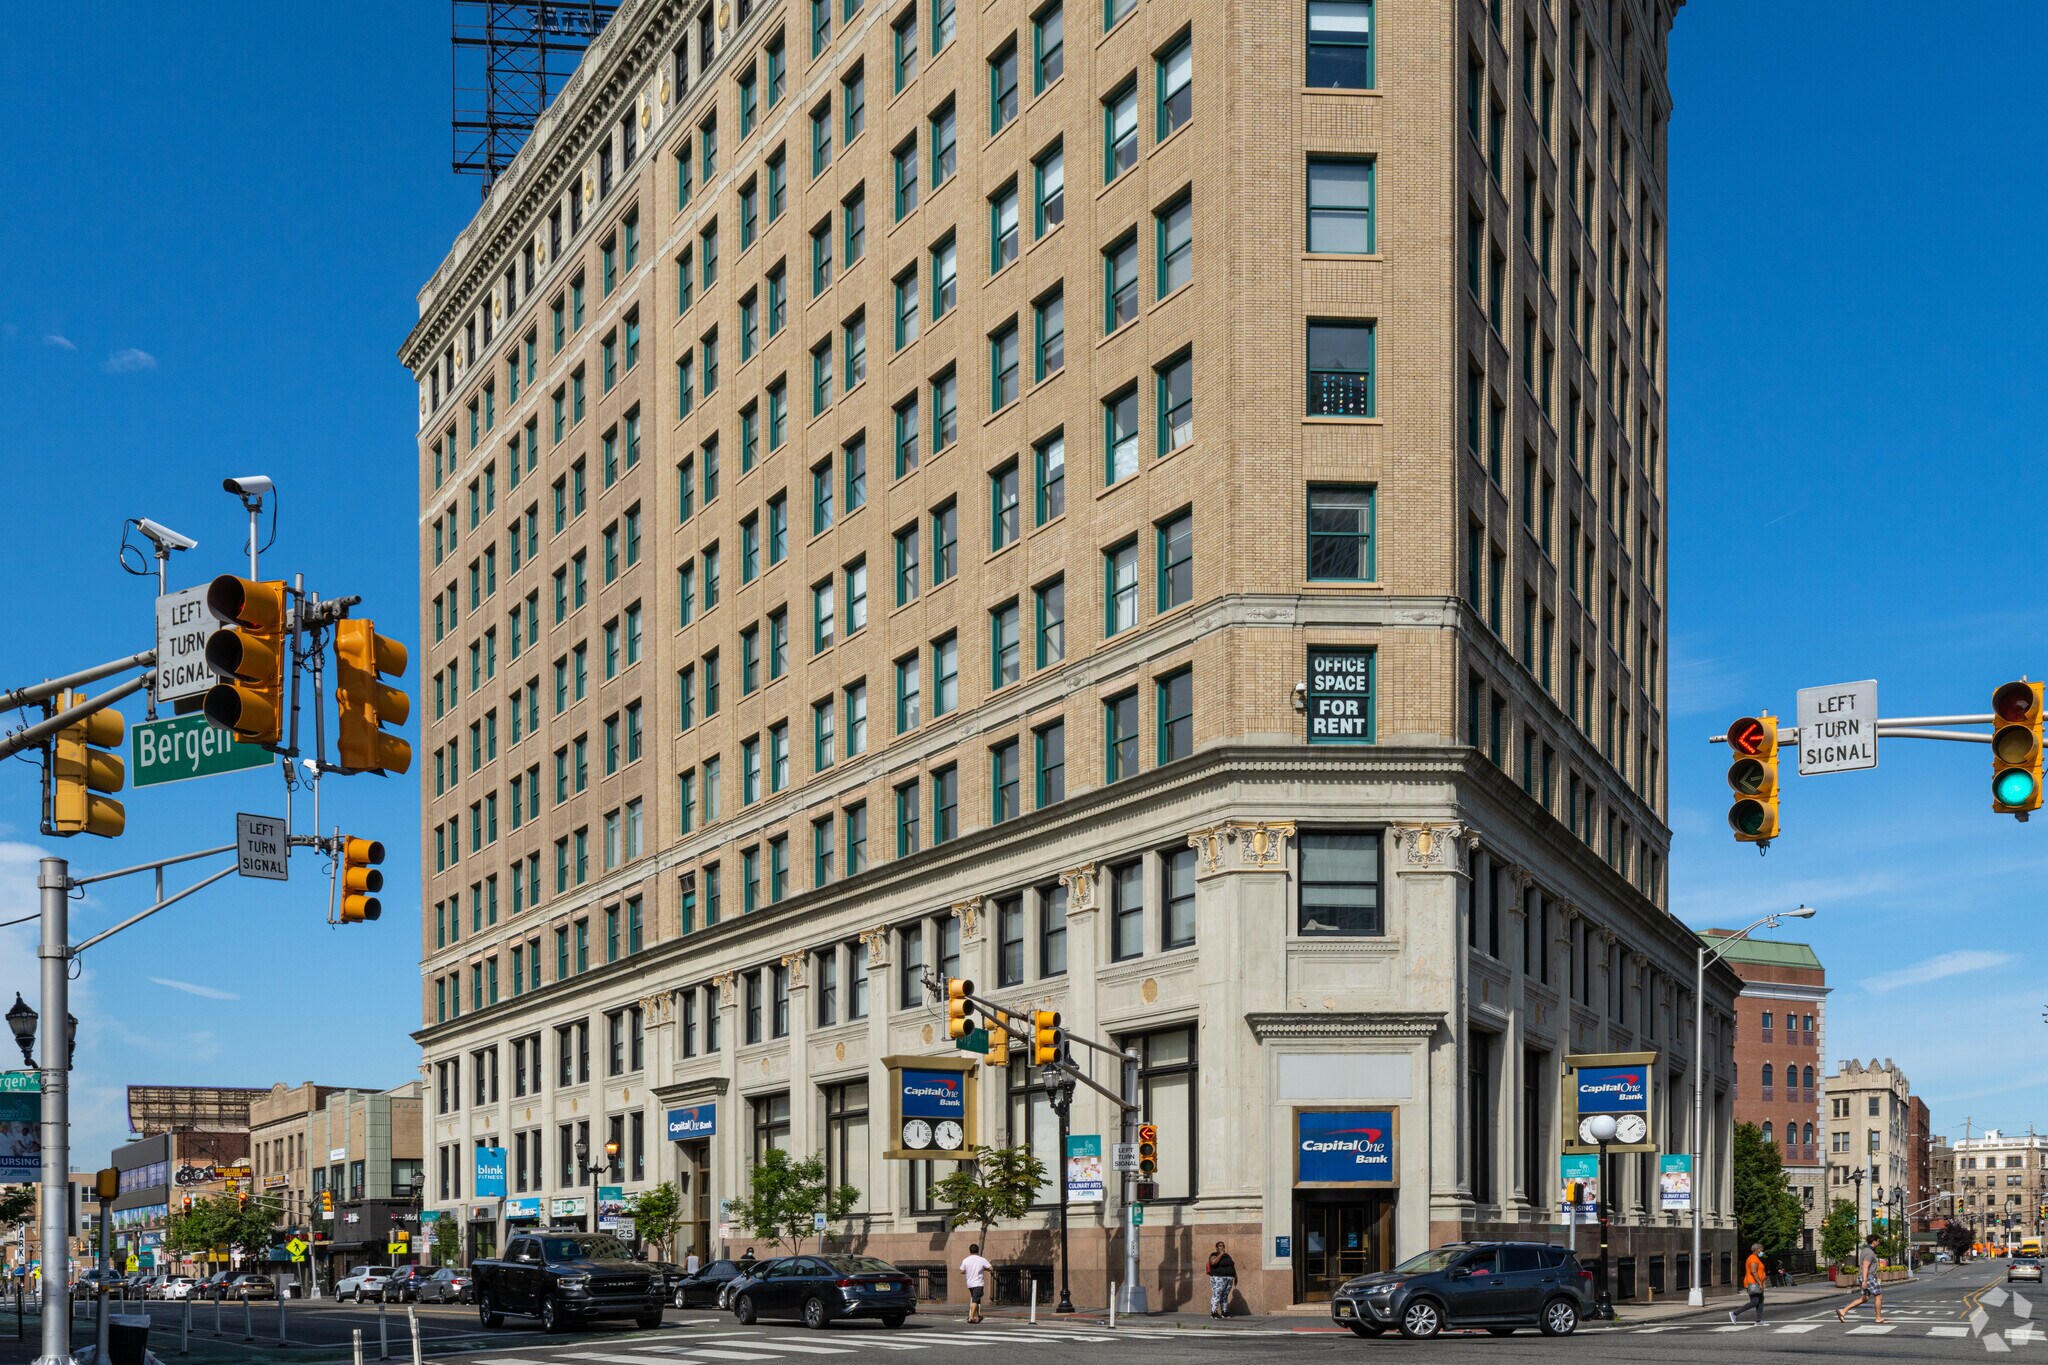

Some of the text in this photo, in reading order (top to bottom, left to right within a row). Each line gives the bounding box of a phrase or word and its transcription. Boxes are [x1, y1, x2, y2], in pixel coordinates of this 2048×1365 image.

[172, 600, 201, 626] LEFT
[169, 631, 205, 657] TURN
[1314, 657, 1365, 672] OFFICE
[162, 661, 214, 689] SIGNAL
[1314, 675, 1365, 691] SPACE
[1319, 699, 1359, 716] FOR
[1818, 694, 1856, 714] LEFT
[1313, 717, 1365, 735] RENT
[1815, 719, 1859, 739] TURN
[140, 726, 231, 772] Bergen
[1807, 742, 1871, 765] SIGNAL
[249, 823, 274, 837] LEFT
[247, 840, 276, 855] TURN
[243, 858, 285, 874] SIGNAL
[939, 1098, 961, 1107] Bank
[700, 1120, 713, 1130] Bank
[0, 1157, 40, 1166] URSING
[1355, 1154, 1388, 1164] Bank
[477, 1164, 504, 1175] blink
[618, 1229, 634, 1239] 25
